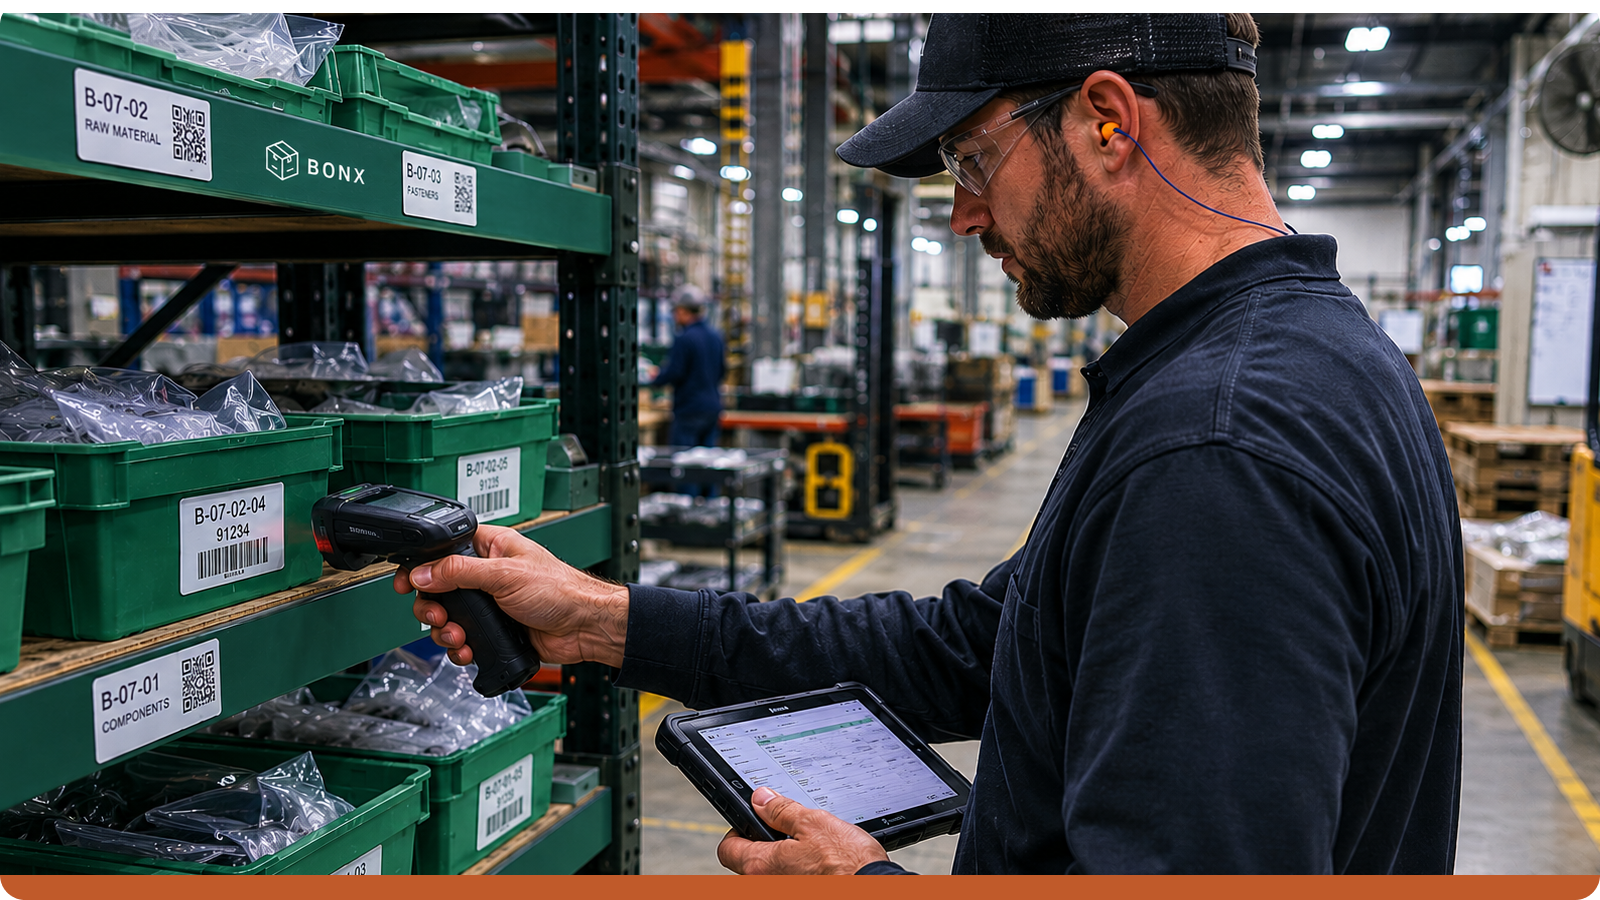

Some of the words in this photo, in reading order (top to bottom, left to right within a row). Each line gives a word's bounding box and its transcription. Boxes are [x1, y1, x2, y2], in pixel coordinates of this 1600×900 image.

[85, 87, 148, 120] B-07-02
[85, 118, 110, 135] RAW
[113, 125, 161, 145] MATERIAL
[307, 158, 365, 185] BONX
[407, 162, 442, 184] B-07-03
[407, 185, 439, 201] FASTENERS
[466, 456, 508, 477] B-07-02-05
[195, 495, 266, 525] B-07-02-04
[216, 523, 250, 542] 91234
[101, 673, 159, 711] B-07-01
[102, 697, 170, 733] COMPONENTS
